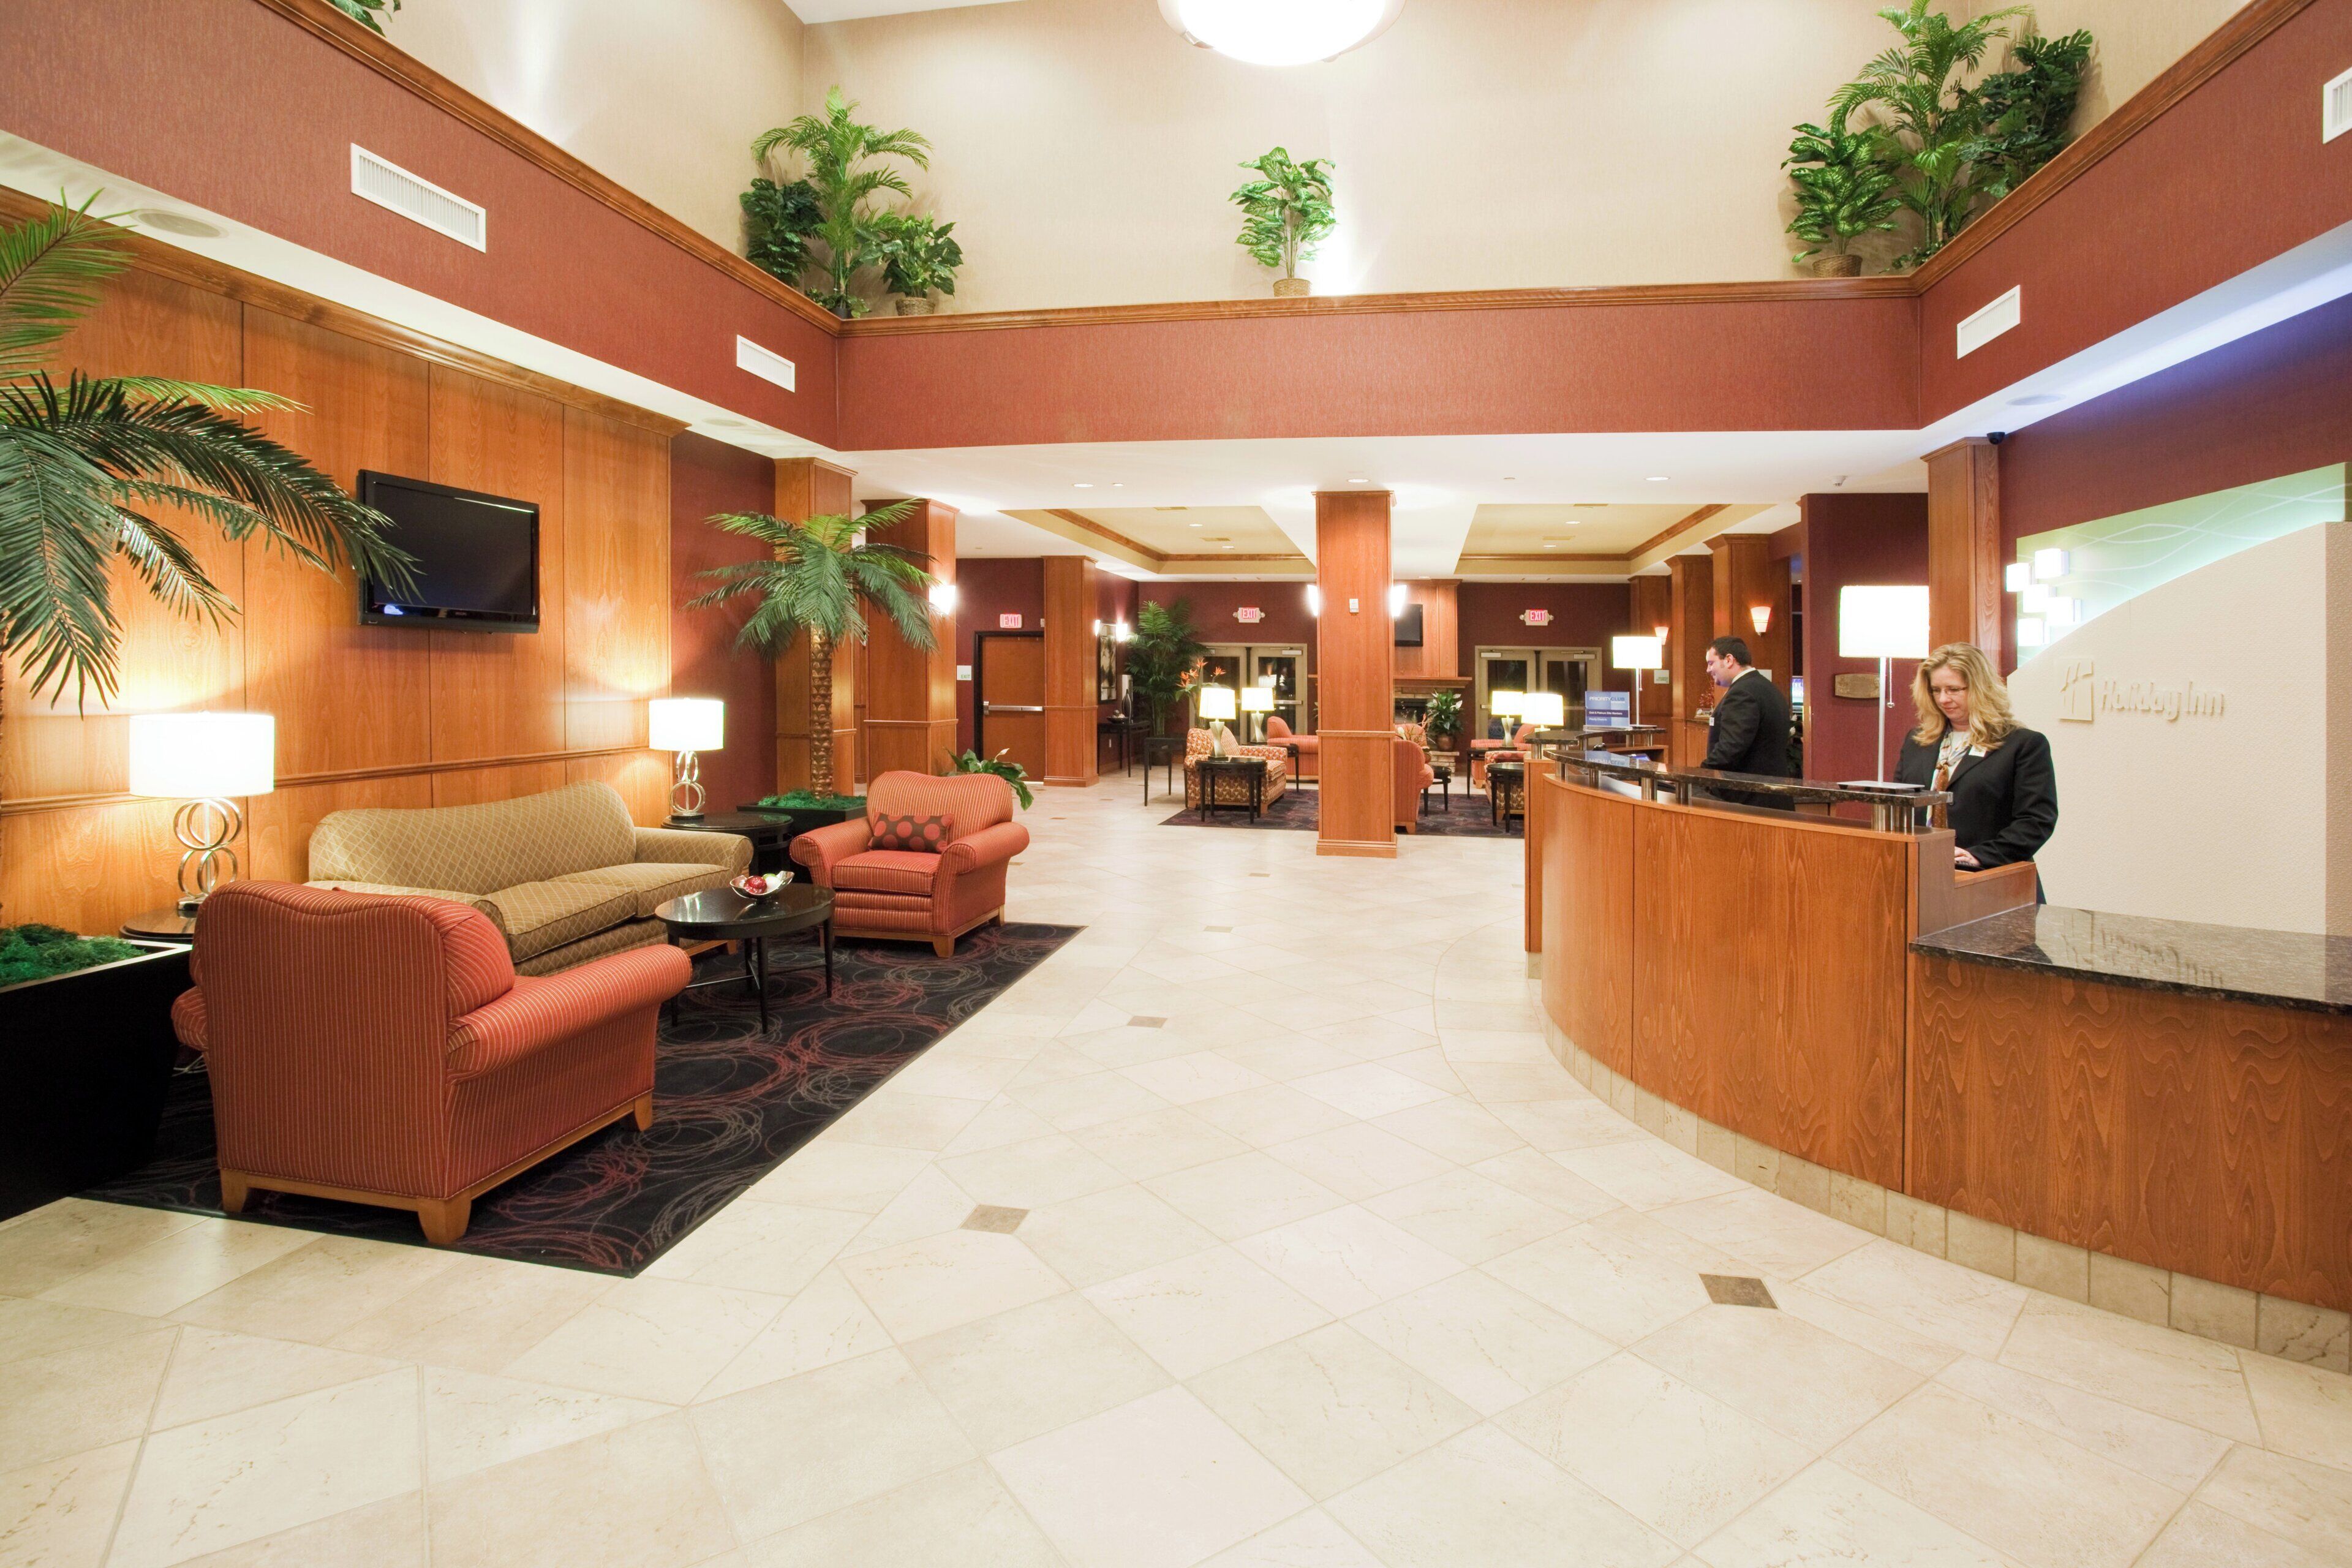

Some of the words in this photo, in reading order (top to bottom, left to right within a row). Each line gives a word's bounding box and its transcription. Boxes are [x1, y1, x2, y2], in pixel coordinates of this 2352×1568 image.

[1242, 608, 1256, 619] EXIT
[1529, 611, 1545, 621] EXIT
[1003, 614, 1019, 627] EXIT
[2101, 680, 2182, 722] Holiday
[2185, 680, 2225, 716] Inn
